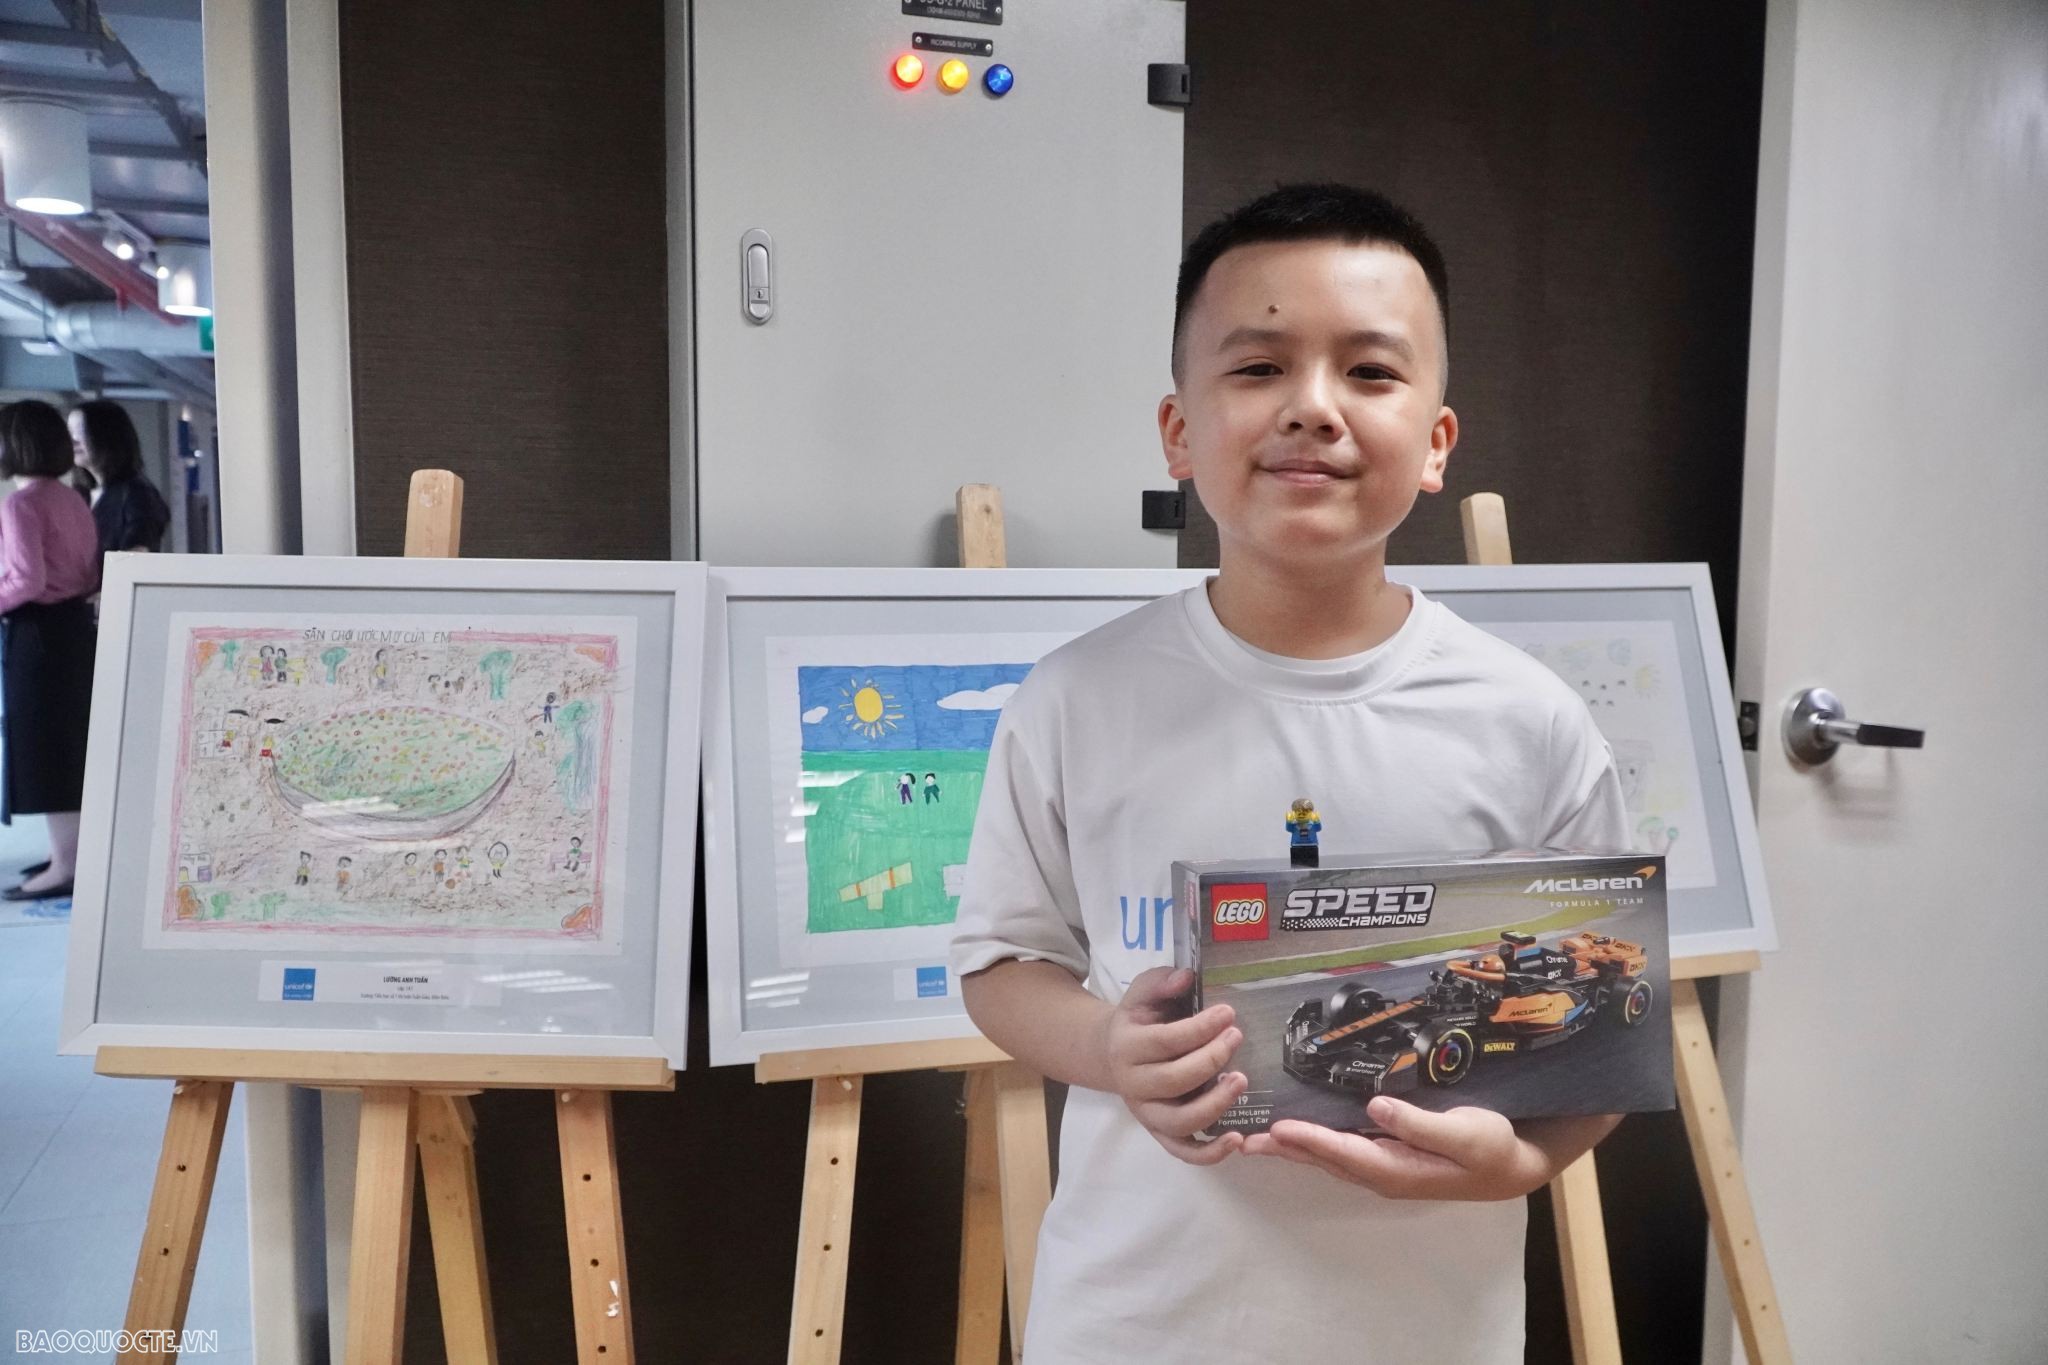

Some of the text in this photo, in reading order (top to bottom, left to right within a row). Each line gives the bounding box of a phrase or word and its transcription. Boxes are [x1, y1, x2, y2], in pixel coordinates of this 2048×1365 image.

[930, 38, 977, 50] INCOMING SUPPLY
[1523, 876, 1643, 894] McLaren
[1284, 886, 1435, 917] SPEED
[1550, 899, 1600, 908] FORMULA
[1215, 900, 1265, 925] LEGO
[1338, 914, 1428, 928] CHAMPIONS
[1508, 1007, 1549, 1017] McLaren
[1238, 1109, 1270, 1117] McLaren
